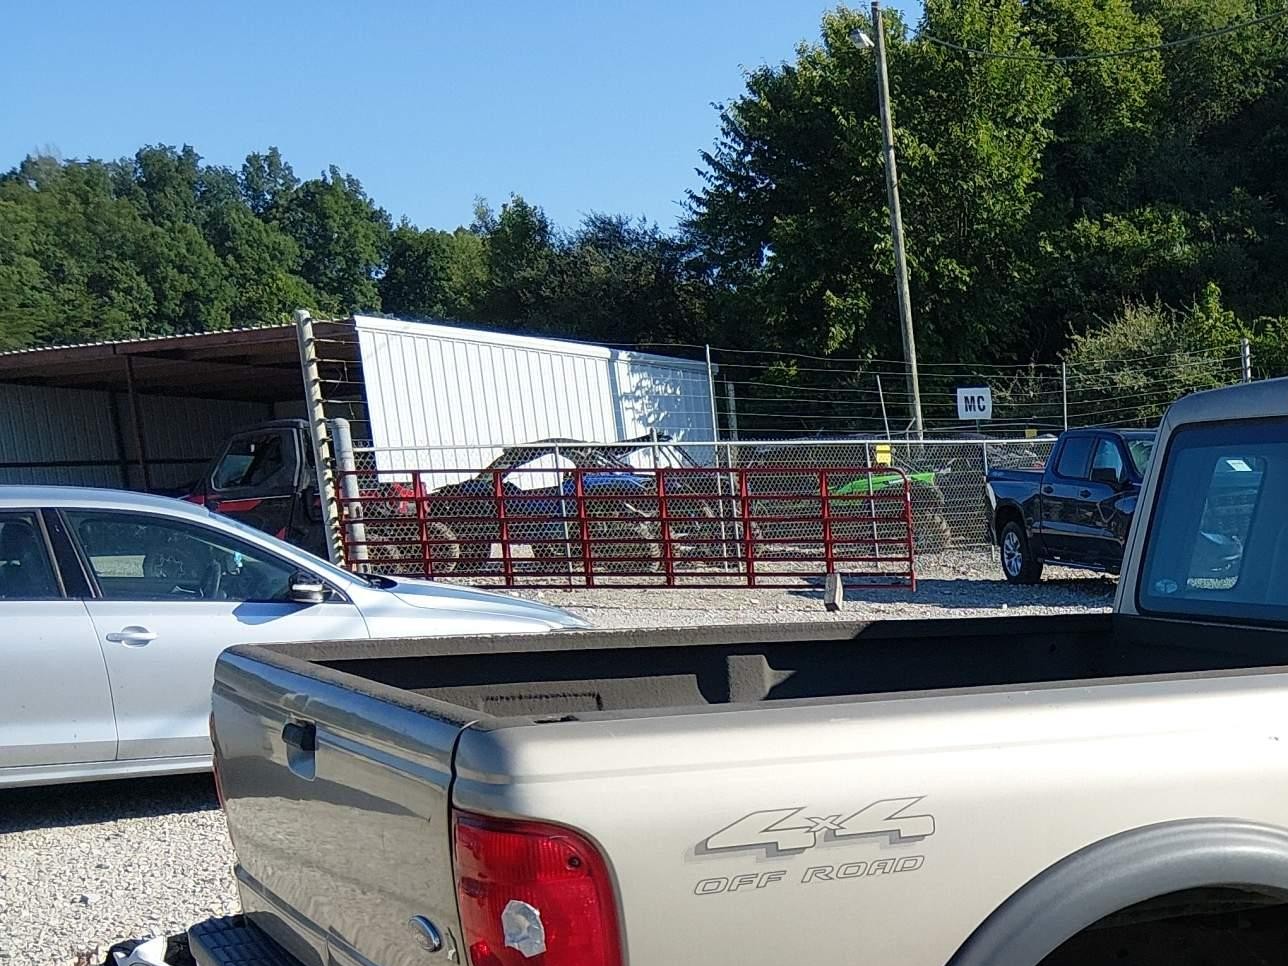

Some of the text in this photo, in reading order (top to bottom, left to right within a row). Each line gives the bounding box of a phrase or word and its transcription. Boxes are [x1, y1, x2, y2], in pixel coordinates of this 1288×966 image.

[964, 395, 986, 412] MC
[694, 855, 926, 896] OFF ROAD
